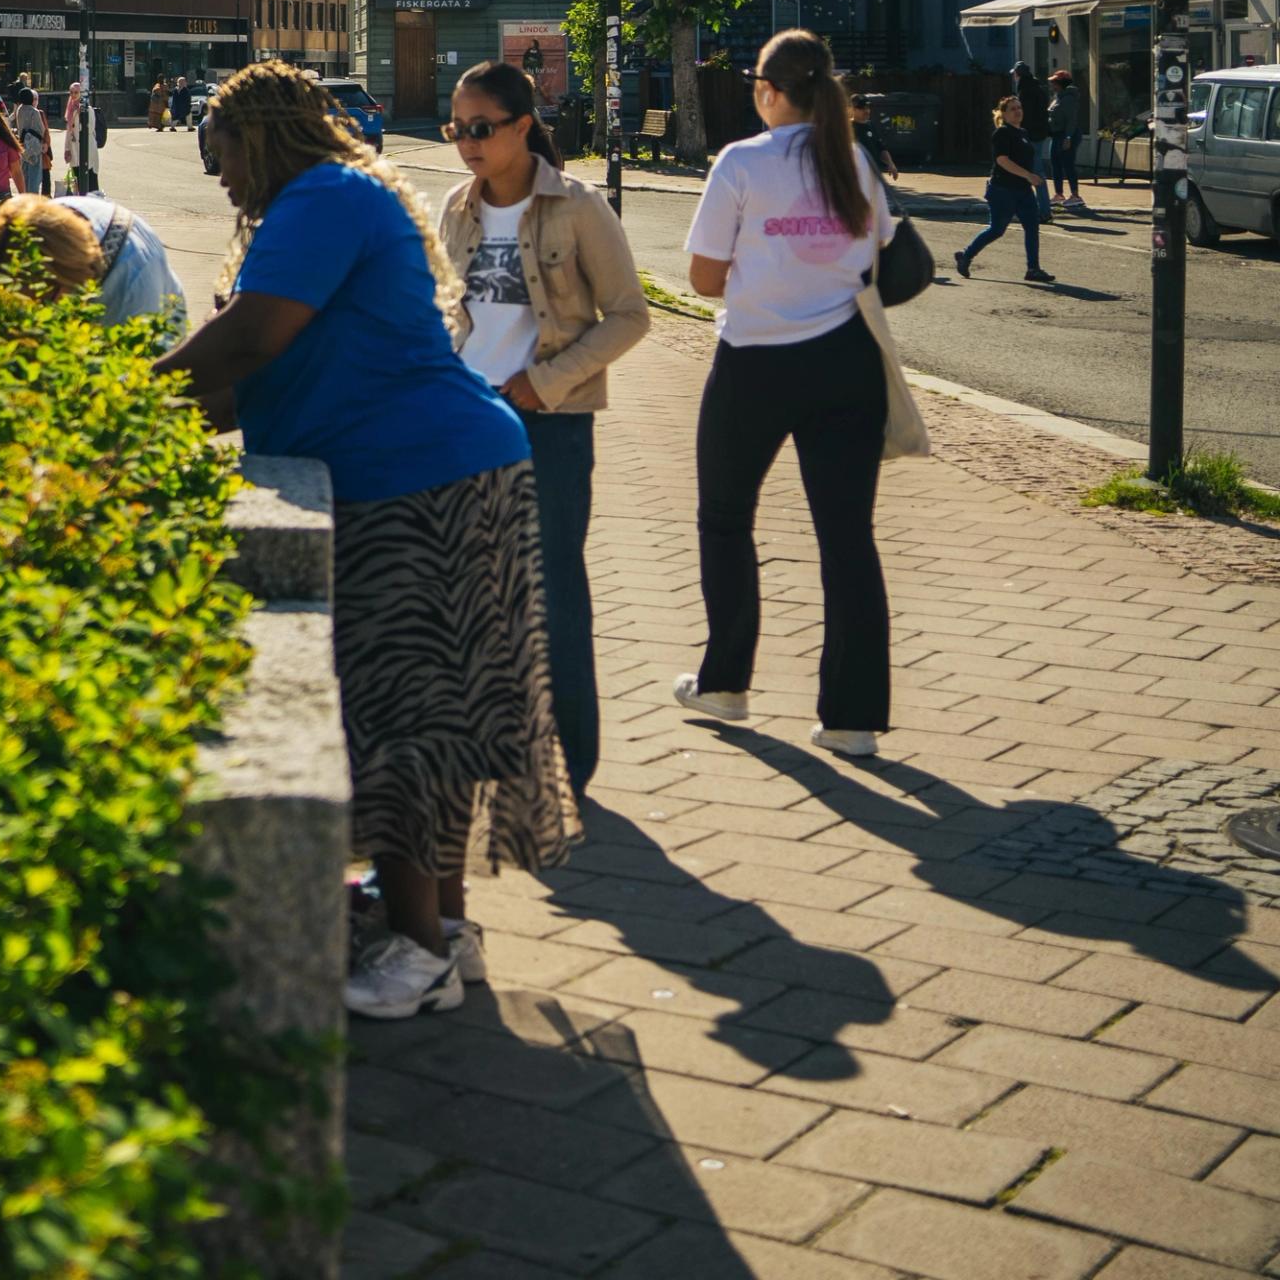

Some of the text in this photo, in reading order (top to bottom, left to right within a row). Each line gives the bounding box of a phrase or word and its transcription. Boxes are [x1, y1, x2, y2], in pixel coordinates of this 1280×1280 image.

[395, 0, 472, 8] FISKERGATA 2
[24, 14, 66, 31] JACOBSEN
